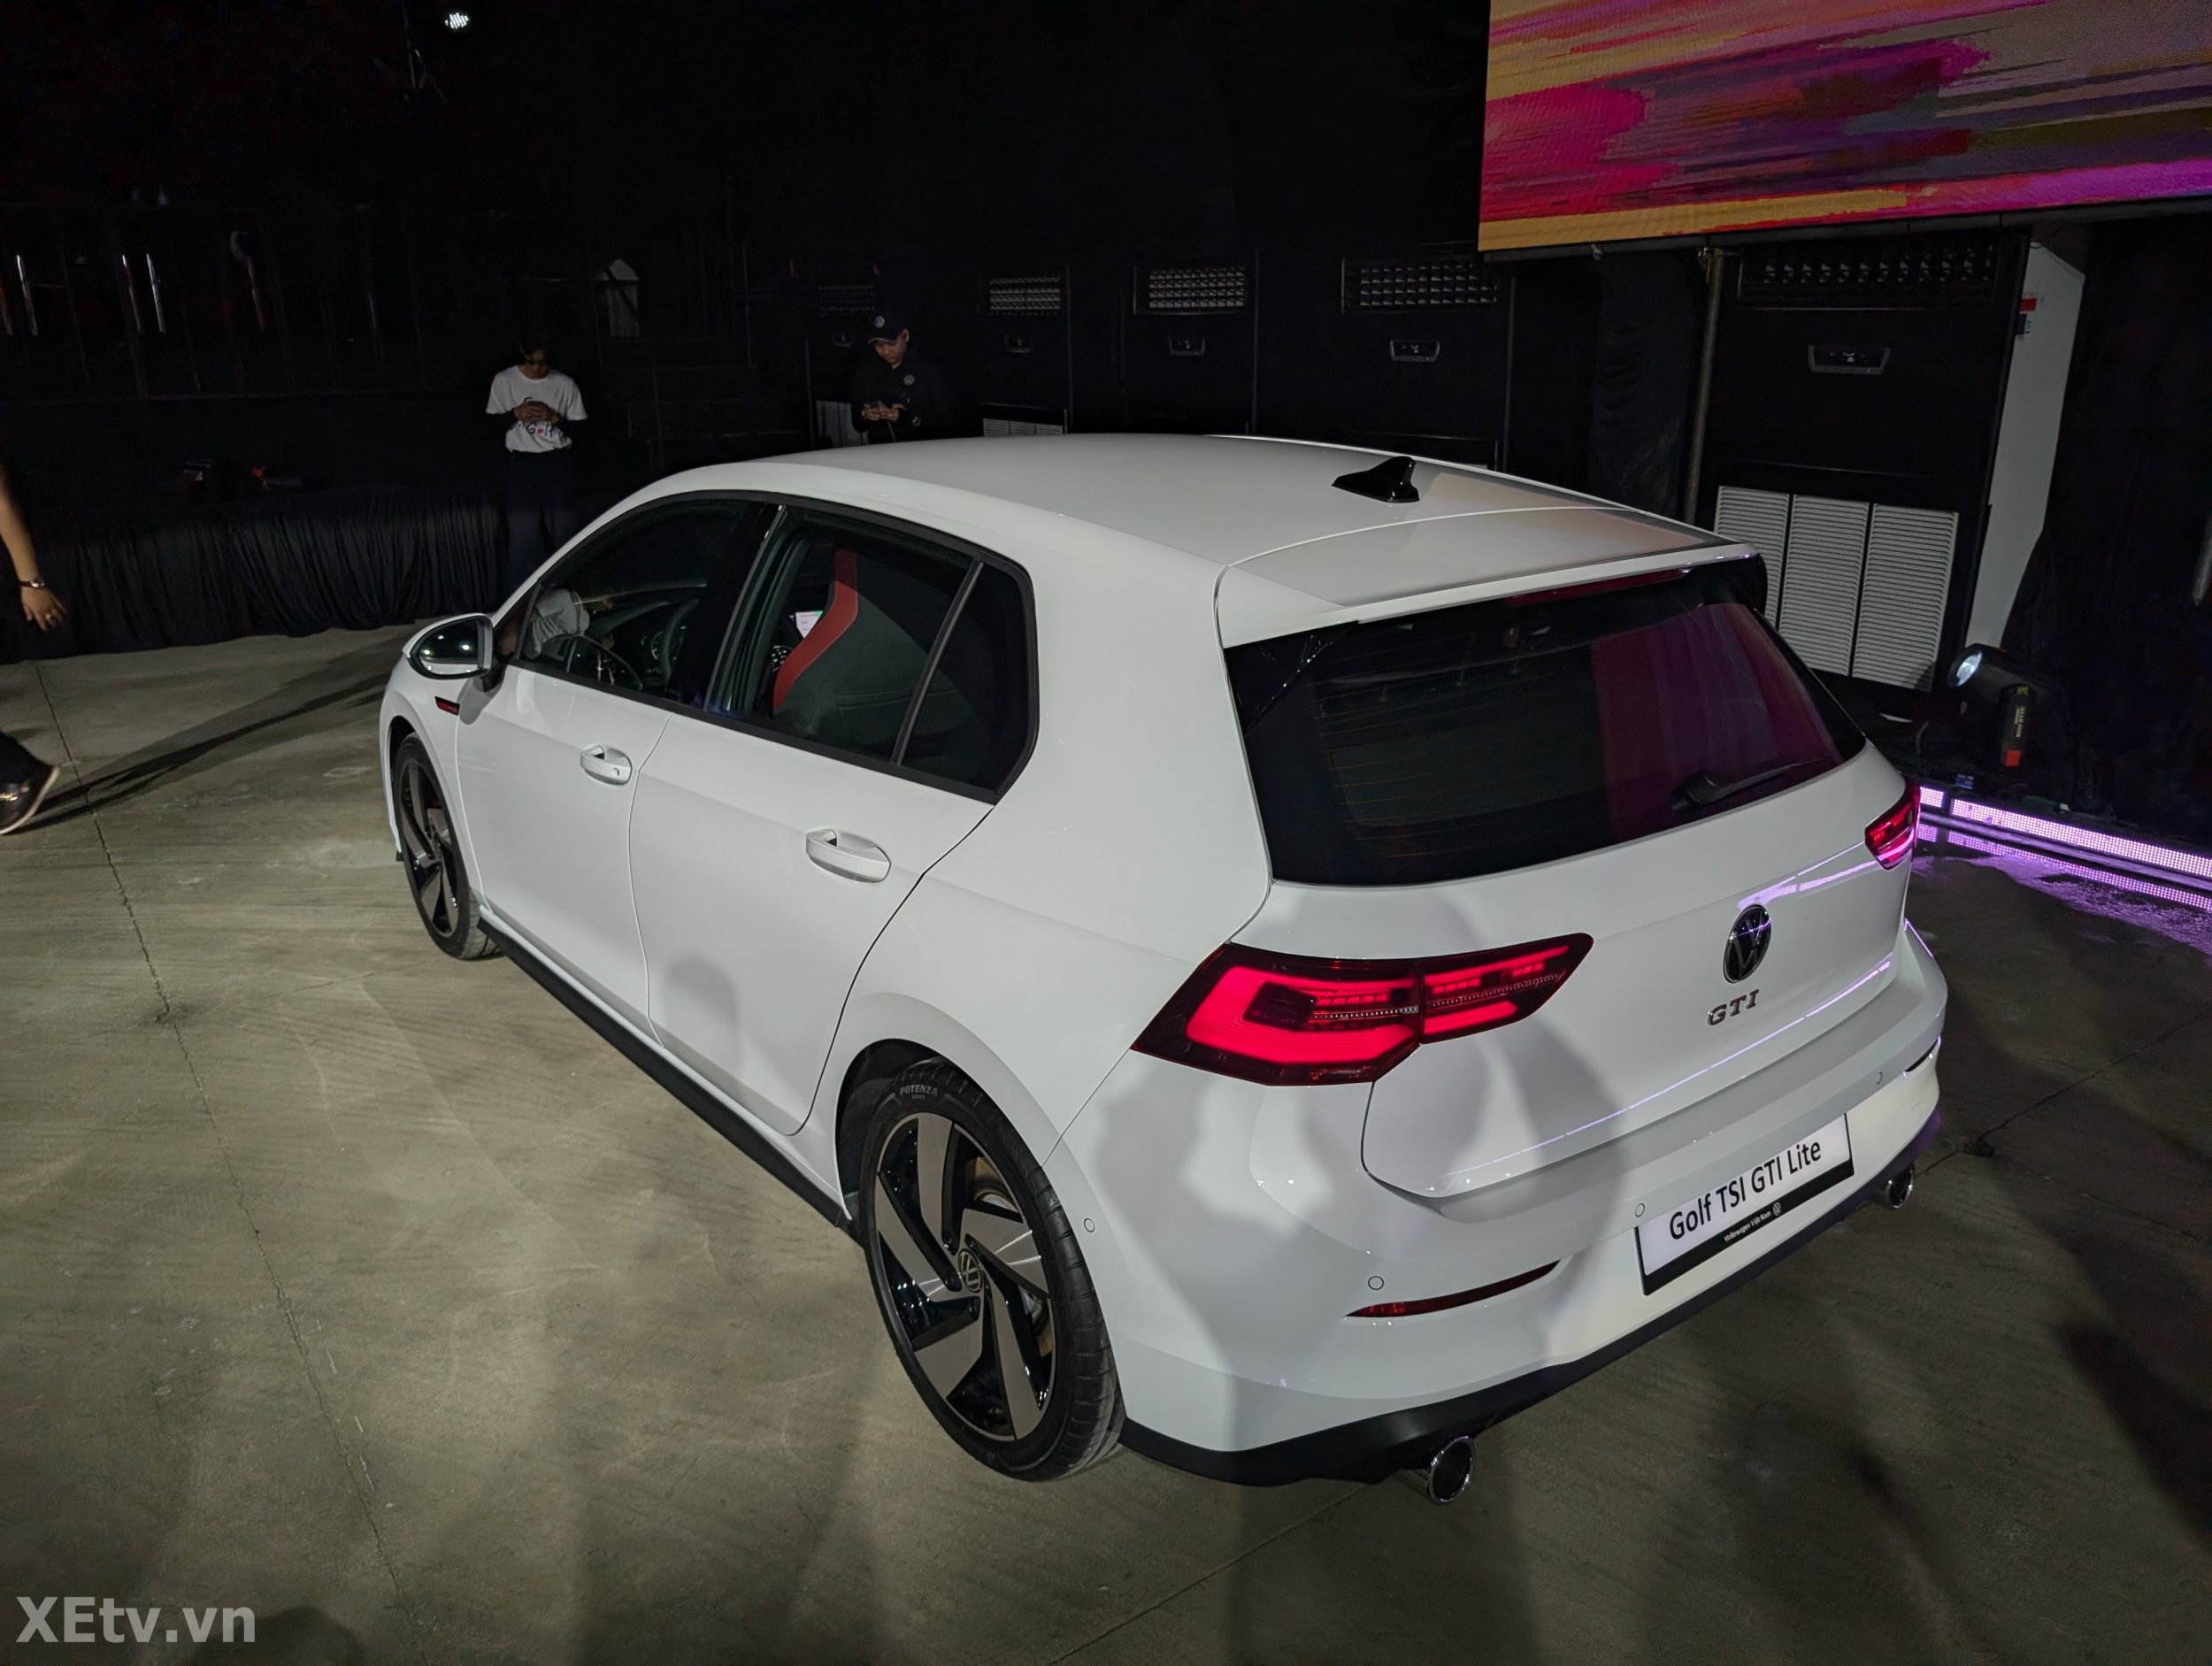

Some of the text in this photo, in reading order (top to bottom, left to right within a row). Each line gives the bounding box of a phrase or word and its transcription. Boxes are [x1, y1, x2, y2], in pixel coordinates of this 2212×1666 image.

[1708, 989, 1759, 1025] GTI
[899, 1084, 938, 1097] POTENZA
[1670, 1141, 1822, 1240] Golf TSI GTI Lite
